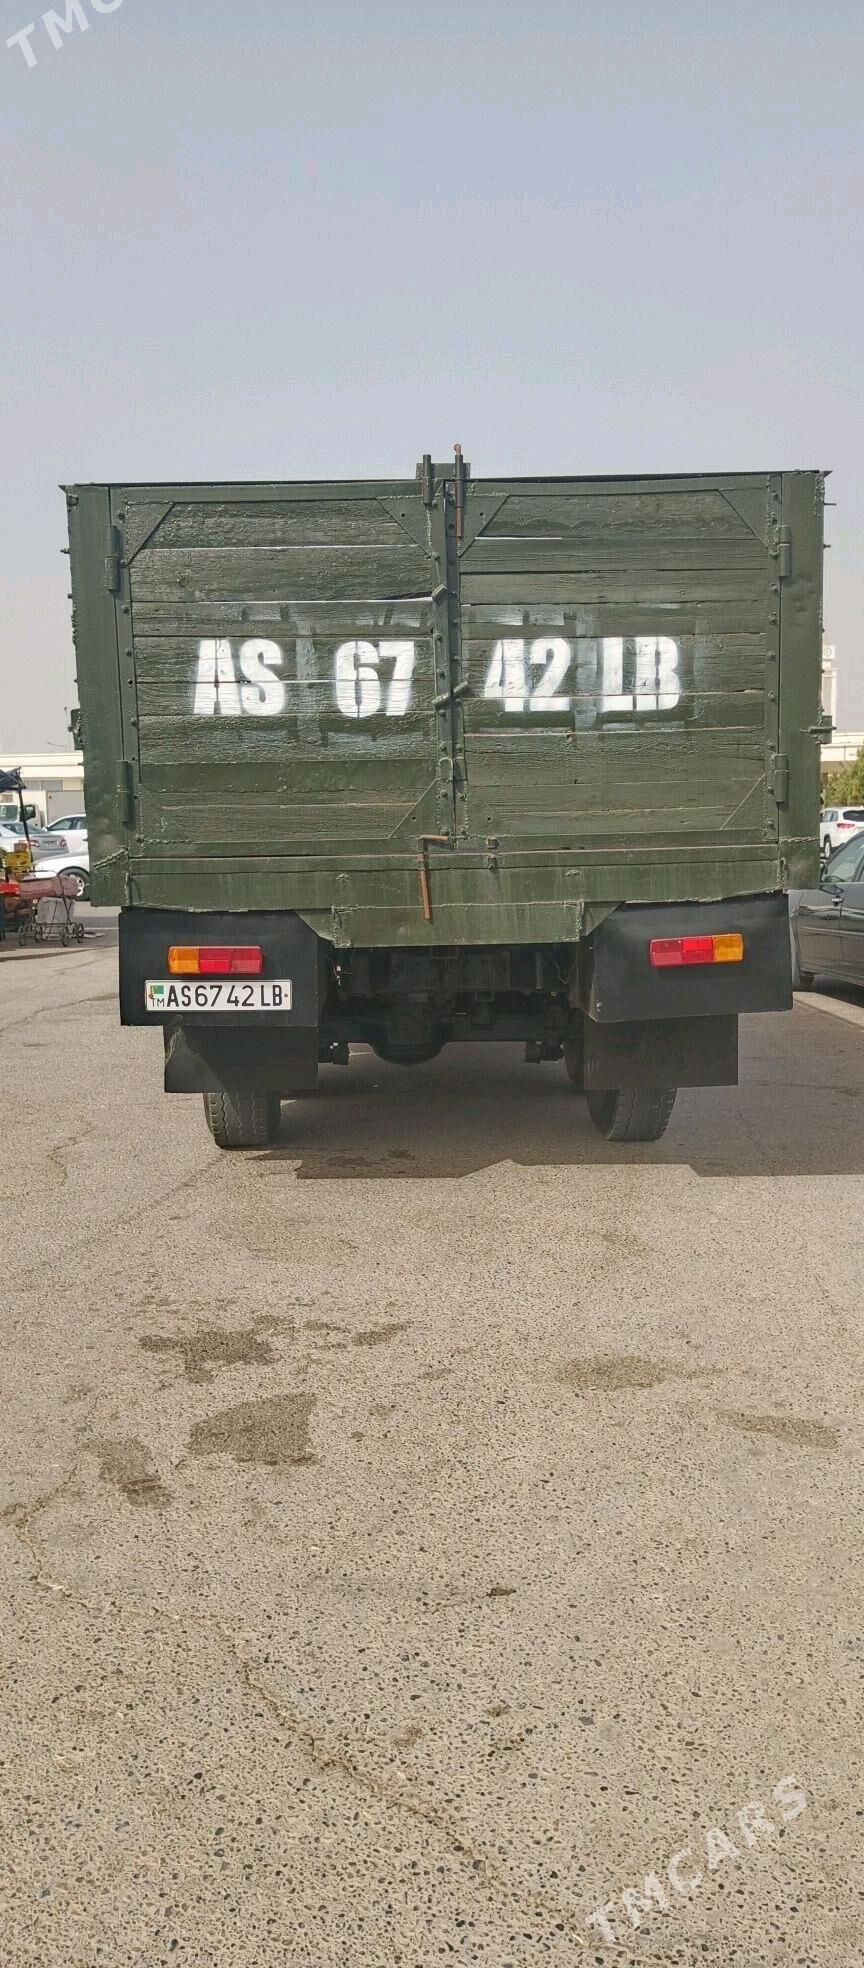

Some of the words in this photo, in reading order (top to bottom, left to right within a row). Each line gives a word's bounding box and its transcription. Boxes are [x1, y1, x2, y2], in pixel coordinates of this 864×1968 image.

[193, 638, 286, 717] AS
[335, 640, 416, 718] 67
[484, 636, 571, 712] 42
[601, 636, 682, 713] LB
